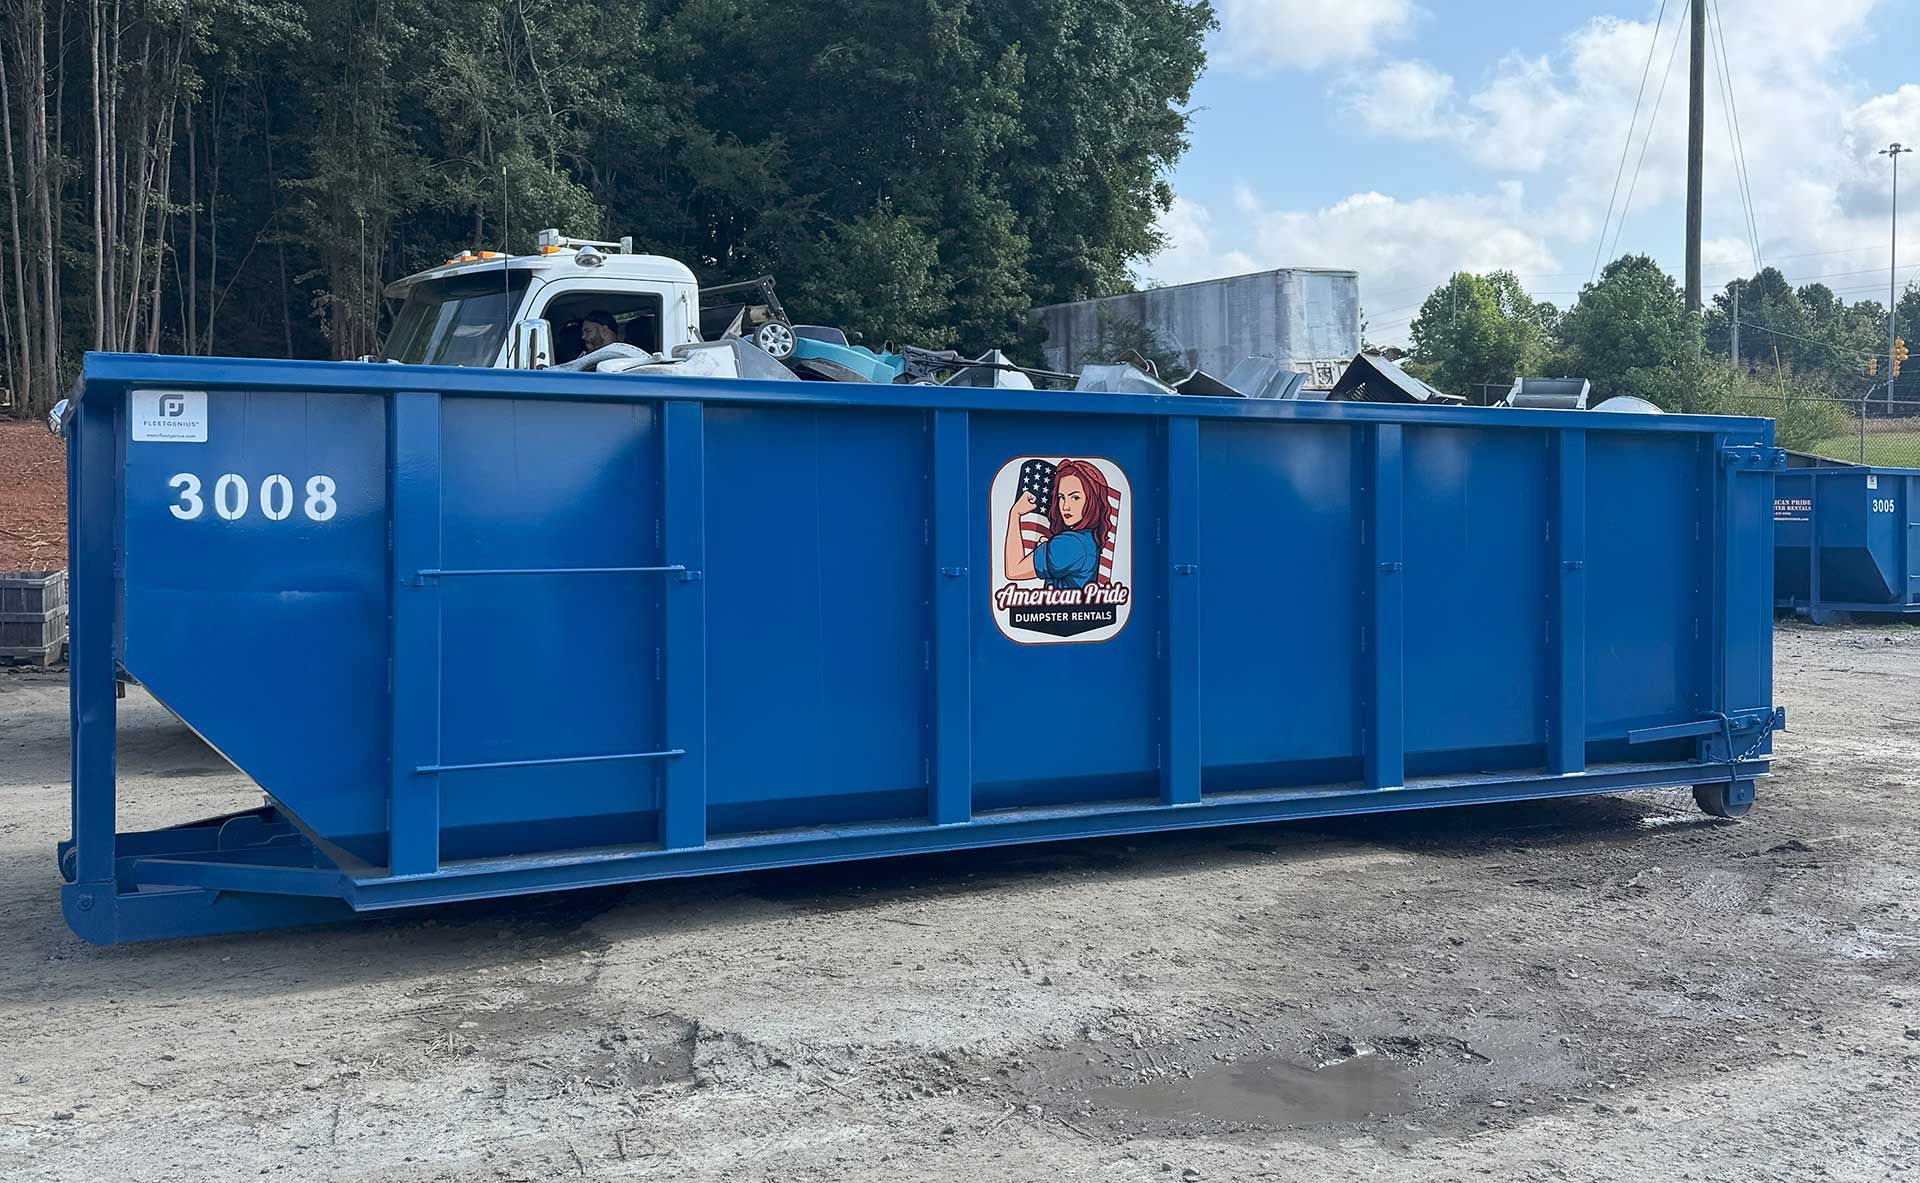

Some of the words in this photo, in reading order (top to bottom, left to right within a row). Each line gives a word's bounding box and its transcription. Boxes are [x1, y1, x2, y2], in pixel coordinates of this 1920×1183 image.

[168, 473, 337, 521] 3008
[1872, 499, 1895, 512] 3005
[996, 584, 1081, 610] American
[1084, 582, 1128, 605] Pride
[1015, 613, 1069, 623] DUMPSTER
[1071, 611, 1112, 621] RENTALS
